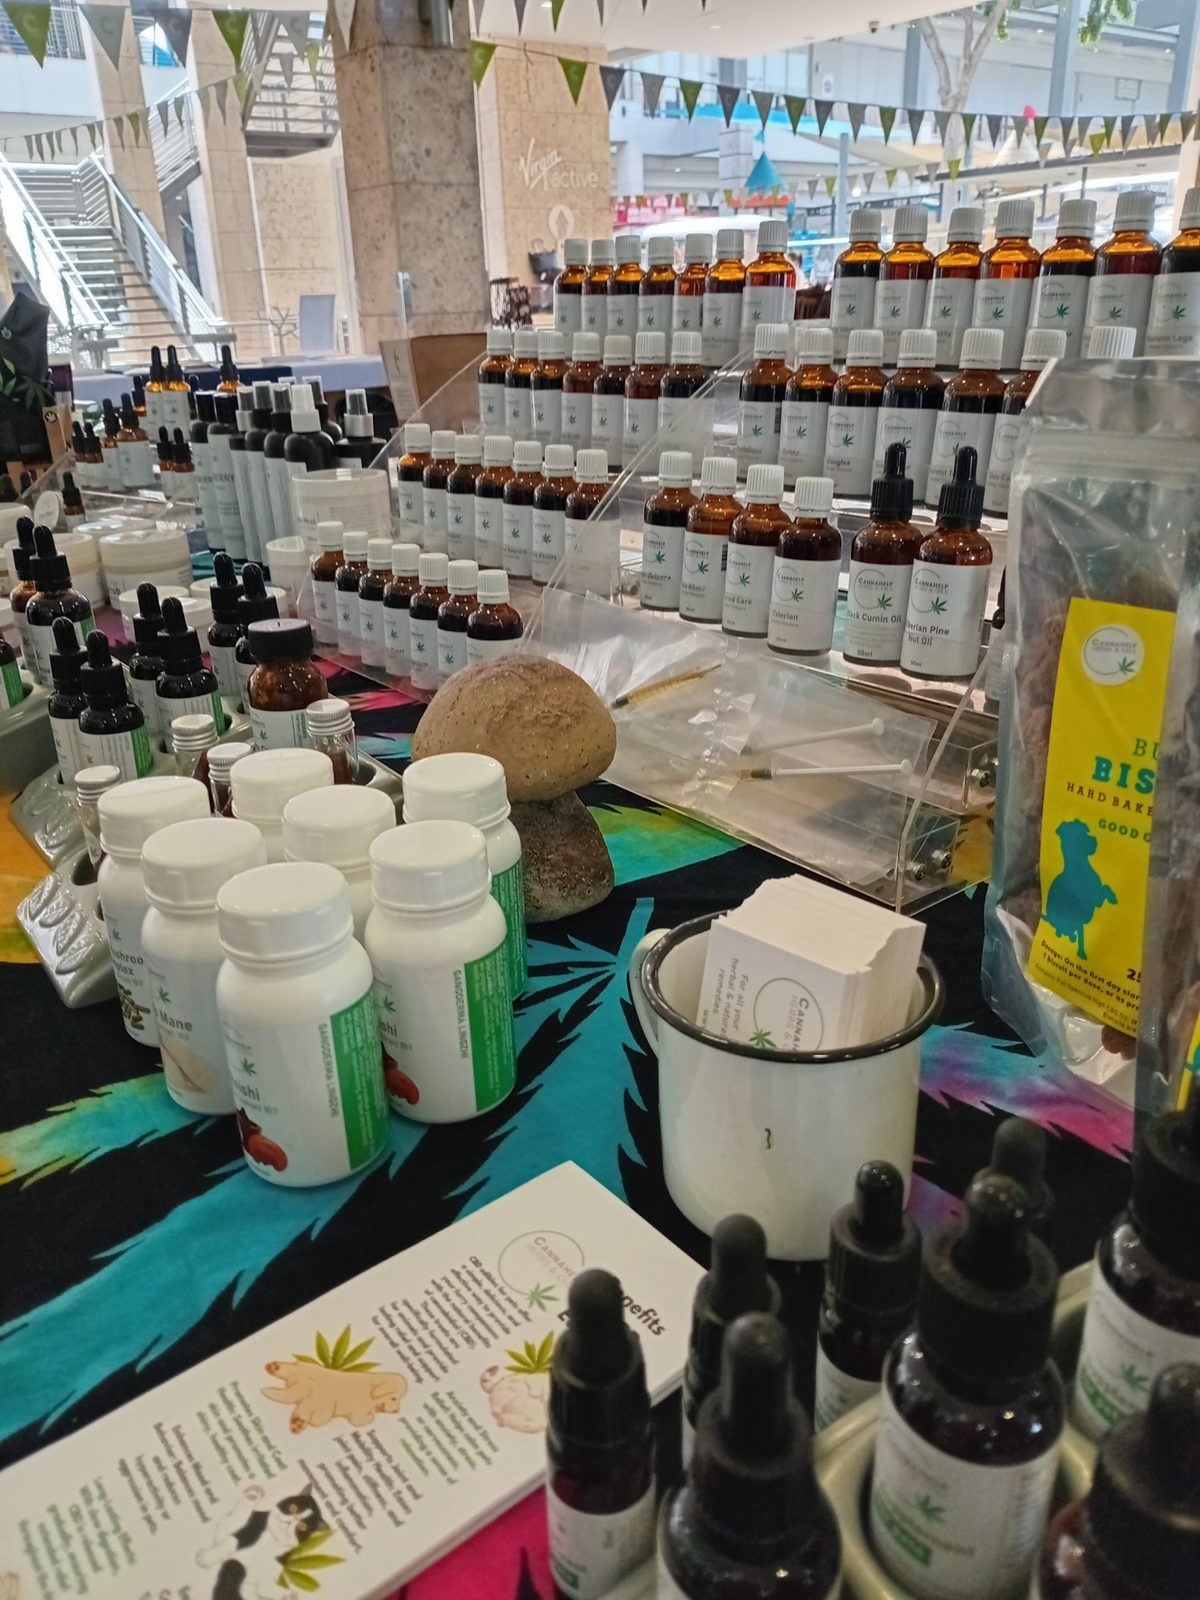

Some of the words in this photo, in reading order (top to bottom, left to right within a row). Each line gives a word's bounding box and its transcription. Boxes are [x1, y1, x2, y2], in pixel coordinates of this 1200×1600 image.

[519, 138, 562, 191] Virgin
[551, 171, 599, 188] active
[862, 613, 888, 623] Cumin
[891, 615, 902, 624] Oil
[921, 635, 934, 647] Oil
[929, 625, 950, 637] Pine
[1067, 782, 1107, 802] HARD
[1098, 818, 1139, 840] GOOD
[728, 957, 739, 991] herbal
[740, 973, 749, 992] For
[1047, 956, 1068, 974] biscuit
[1069, 970, 1081, 981] per
[1105, 989, 1114, 998] or
[1115, 995, 1125, 1004] as
[1064, 957, 1075, 968] On
[1075, 963, 1088, 974] the
[1089, 970, 1105, 984] first
[1106, 980, 1121, 993] day
[453, 969, 466, 1029] GANODERMA
[736, 993, 745, 1008] all
[160, 1010, 193, 1031] Mane
[733, 1008, 742, 1031] your
[457, 1029, 470, 1060] LINGZHI
[318, 1022, 334, 1083] GANODERMA
[326, 1083, 340, 1118] LINGZHI
[469, 1256, 482, 1268] CBD
[622, 1293, 667, 1337] nefits
